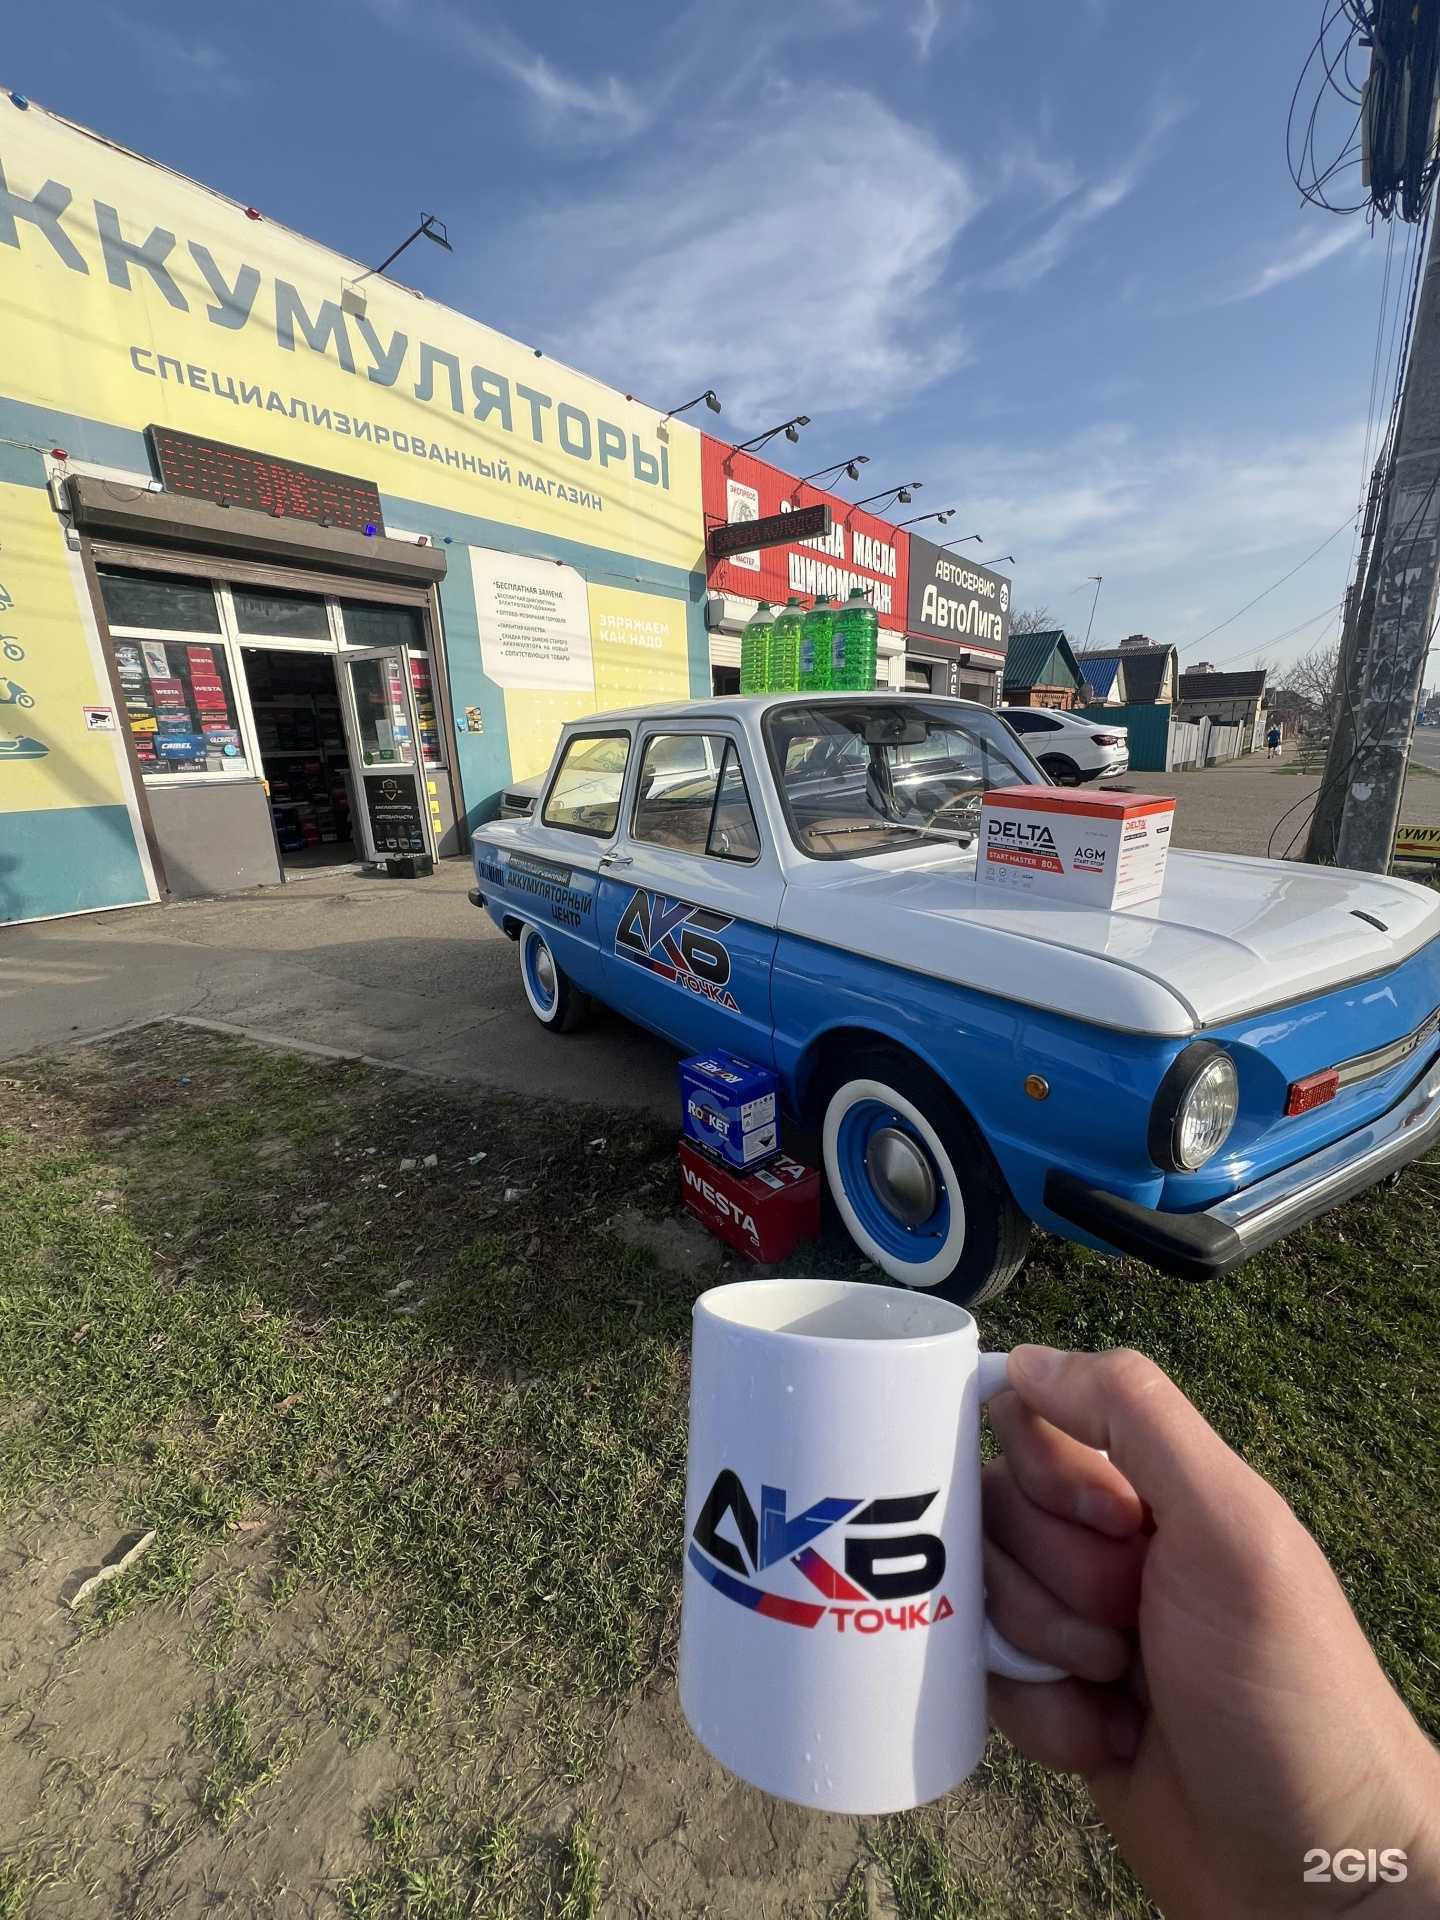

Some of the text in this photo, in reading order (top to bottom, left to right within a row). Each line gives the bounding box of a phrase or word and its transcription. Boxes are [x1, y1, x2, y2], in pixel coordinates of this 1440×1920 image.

[130, 346, 512, 484] СПЕЦИАЛИЗИРОВАННЫЙ
[518, 470, 603, 512] МАГАЗИН
[852, 530, 897, 579] МАСЛА
[496, 581, 563, 599] БЕСПЛАТНАЯ ЗАМЕНА
[935, 560, 996, 599] АВТОСЕРВИС
[630, 634, 664, 649] НАДО
[988, 819, 1056, 848] DELTA
[1125, 819, 1146, 831] DELTA
[989, 852, 1009, 860] START
[1009, 855, 1037, 865] MASTER
[1075, 847, 1106, 861] AGM
[507, 871, 593, 916] АККУМУЛЯТОРНЫЙ
[551, 904, 581, 927] ЦЕНТР
[616, 888, 736, 986] АКБ
[676, 971, 742, 1015] ТОЧКА
[681, 1164, 760, 1240] WESTA
[691, 1468, 947, 1602] АКБ
[828, 1594, 955, 1635] ТОЧКА
